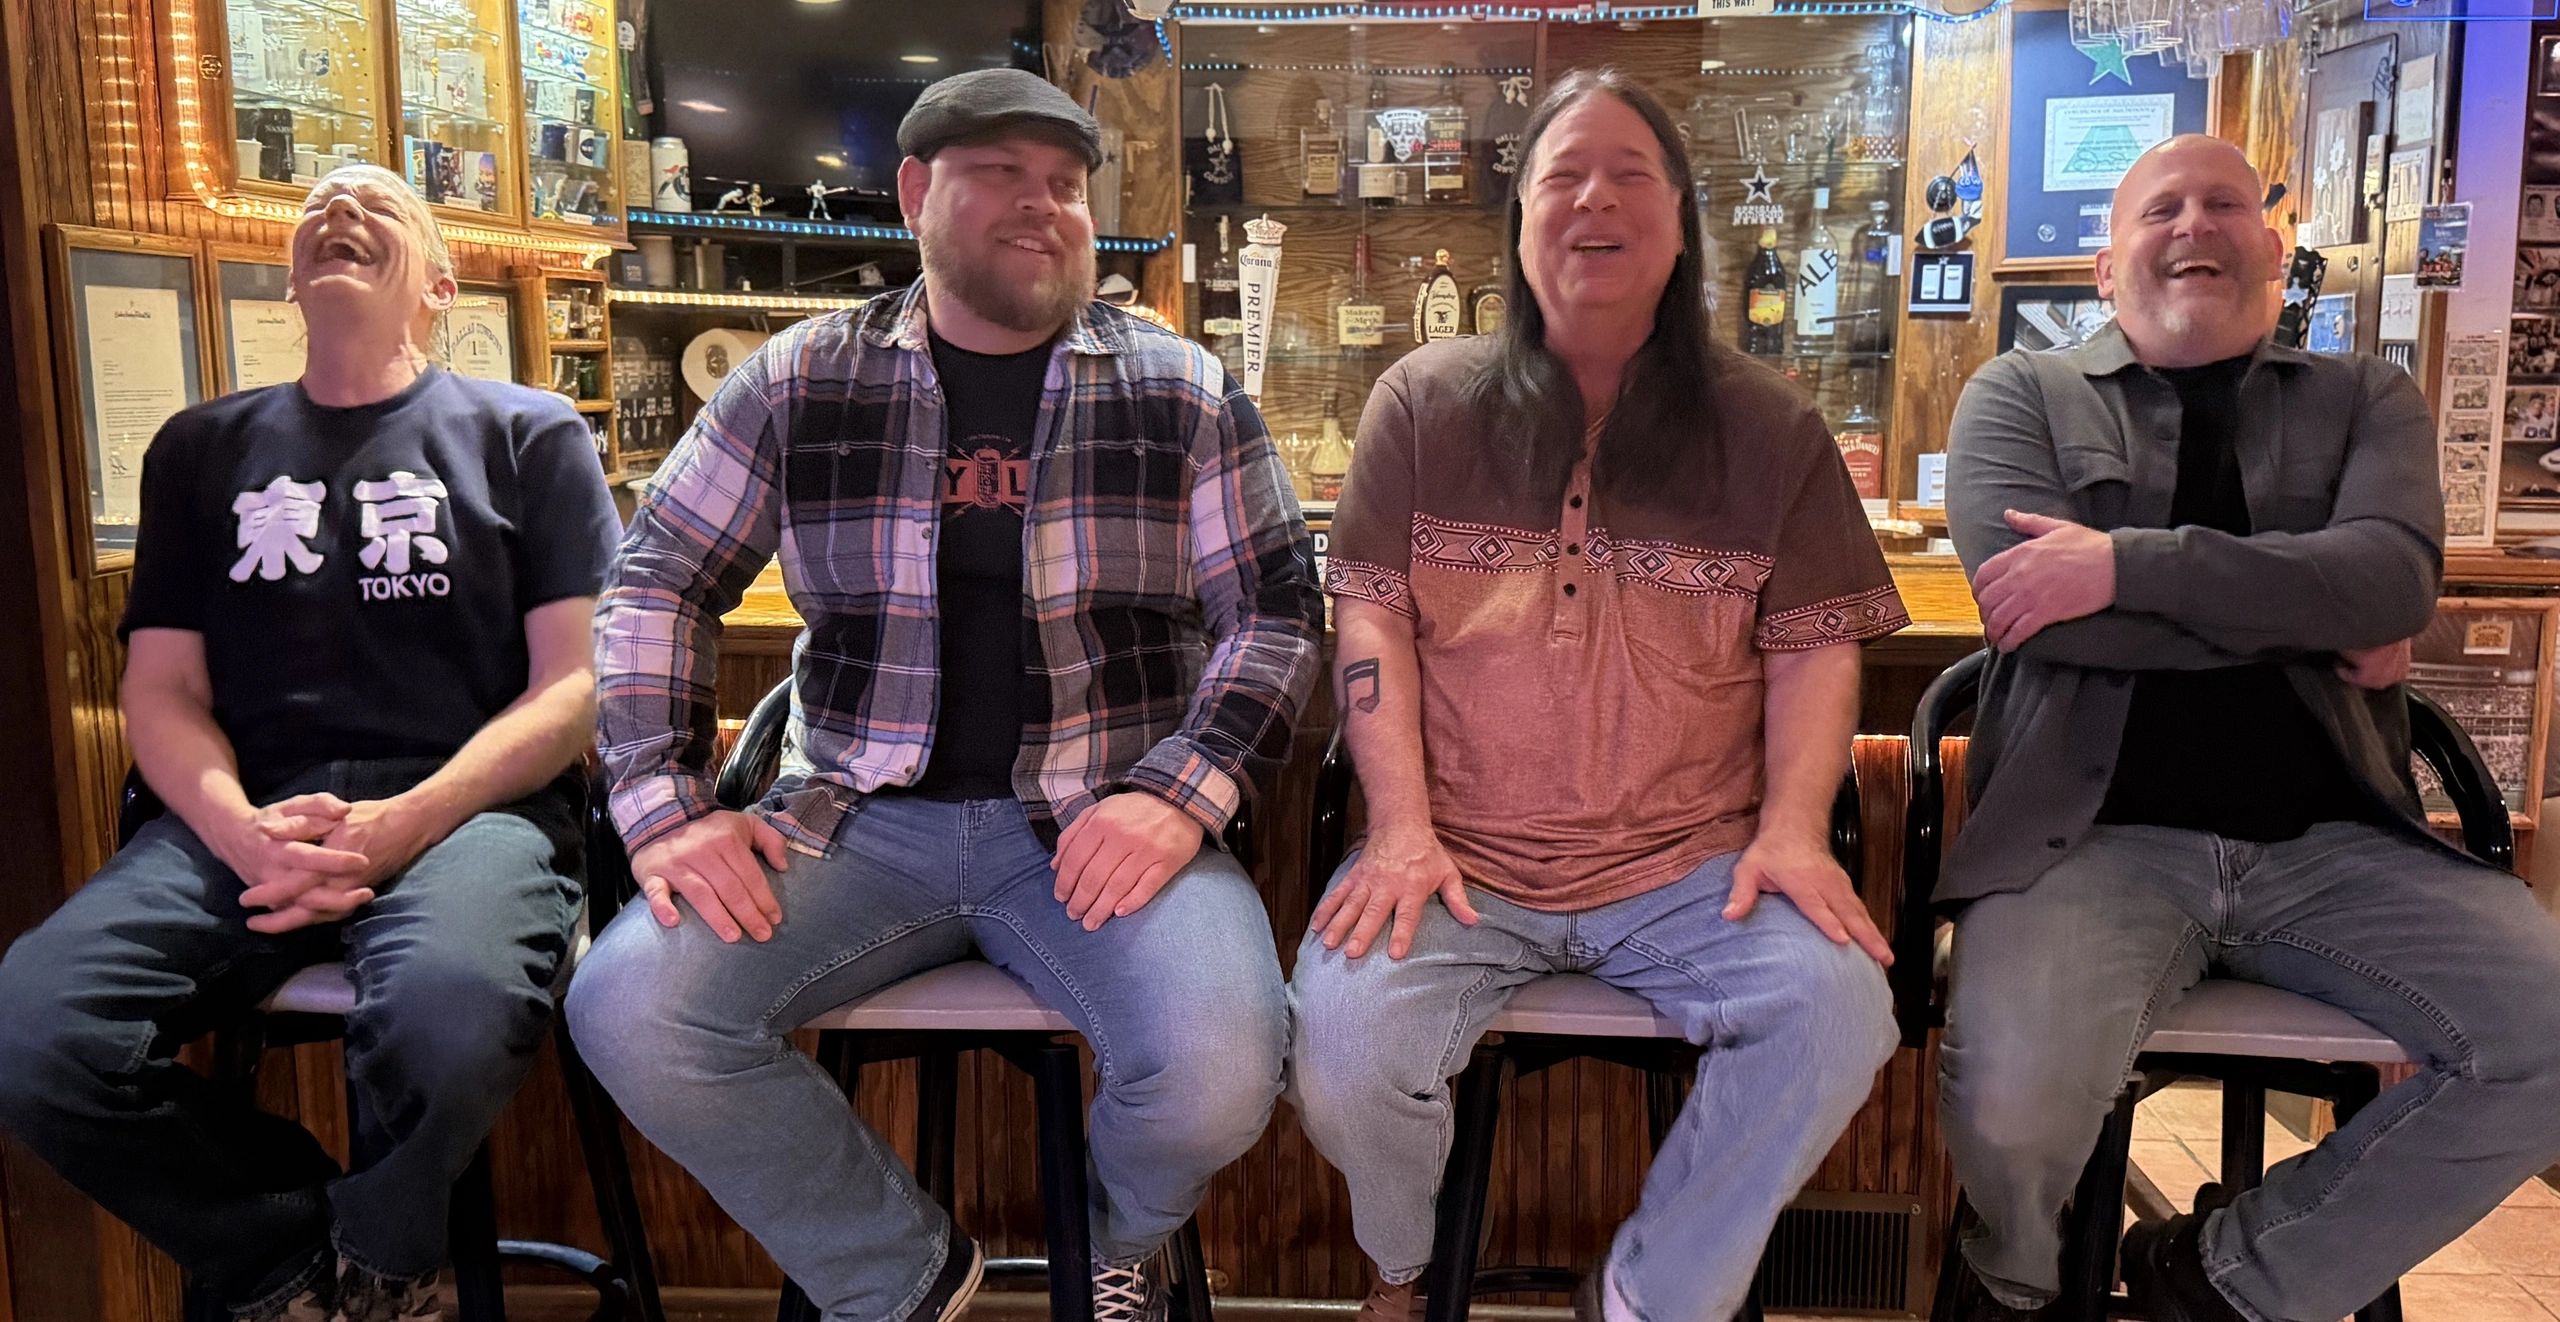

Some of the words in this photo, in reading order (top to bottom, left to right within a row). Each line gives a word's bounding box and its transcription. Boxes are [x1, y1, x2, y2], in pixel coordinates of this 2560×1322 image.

[1712, 0, 1730, 9] THIS
[1734, 0, 1755, 8] WAY!
[1240, 254, 1272, 268] Corona
[1248, 282, 1260, 373] PREMIER
[1428, 325, 1455, 334] LAGER
[229, 471, 448, 583] 東京
[358, 572, 451, 601] TOKYO
